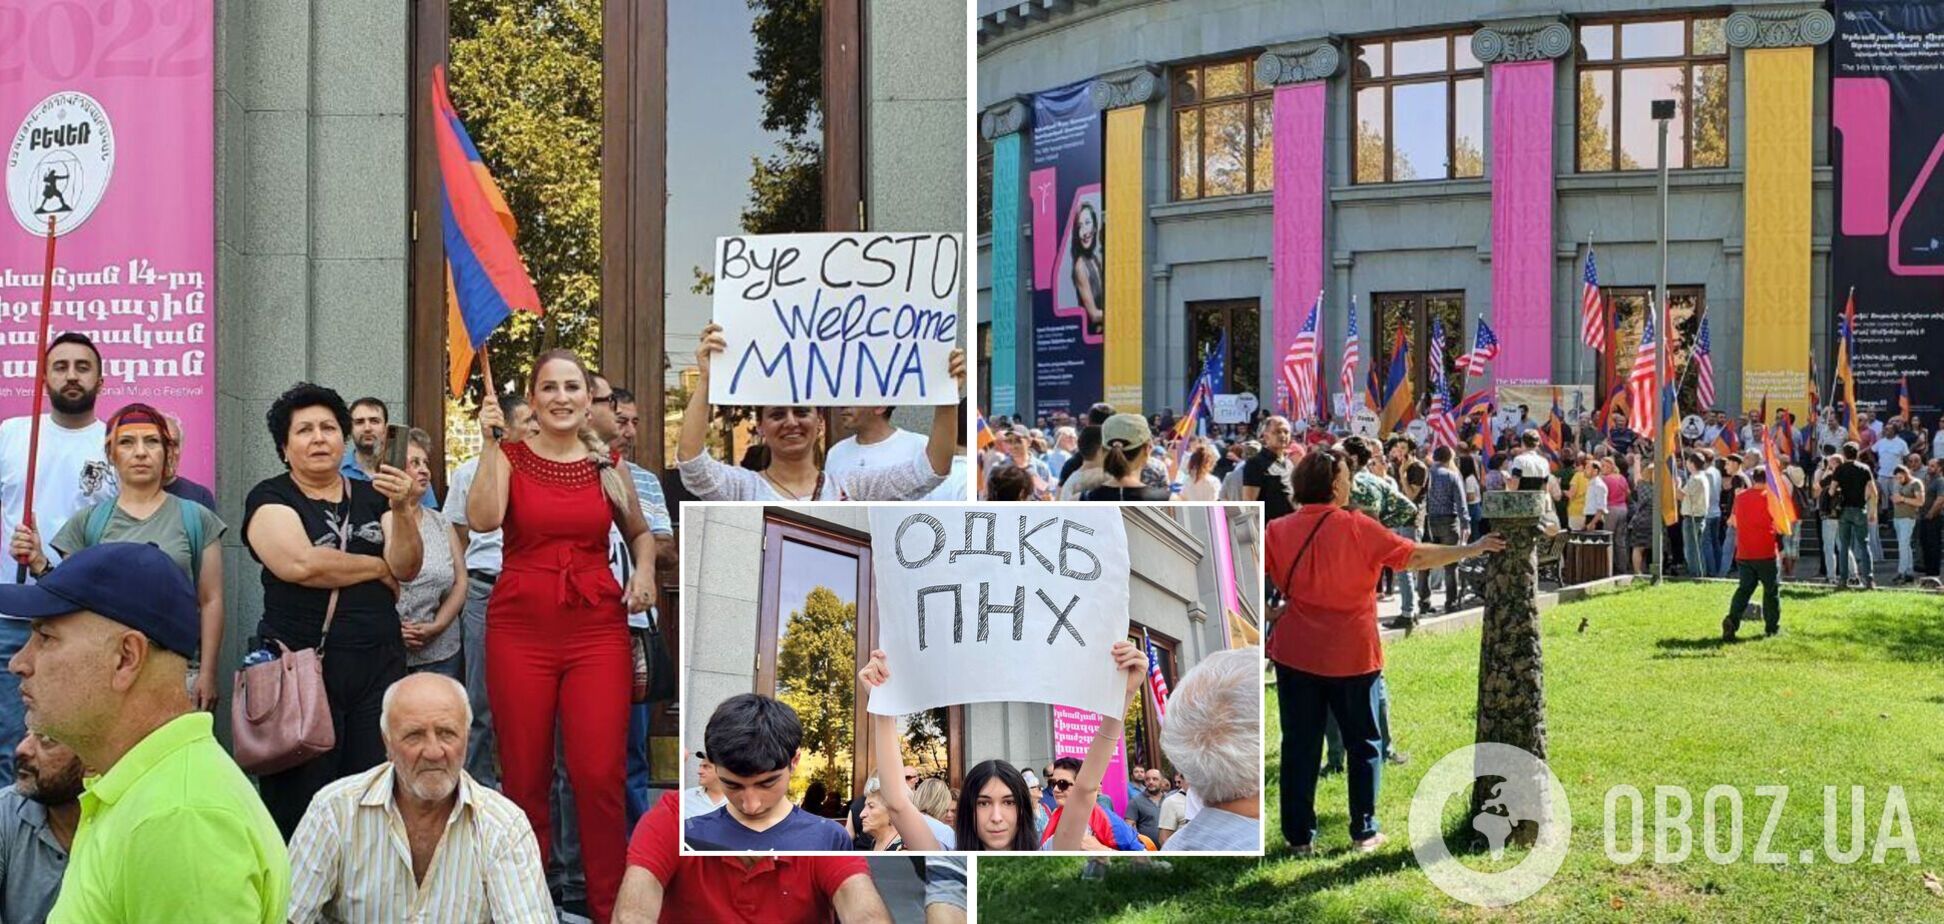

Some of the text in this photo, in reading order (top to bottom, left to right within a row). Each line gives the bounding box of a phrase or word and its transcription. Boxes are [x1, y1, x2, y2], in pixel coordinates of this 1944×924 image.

[722, 234, 959, 300] Bye CSTO
[773, 288, 956, 342] Welcome
[729, 340, 926, 403] MNNA
[895, 511, 1102, 581] ОДКБ
[917, 582, 1086, 651] ПНХ
